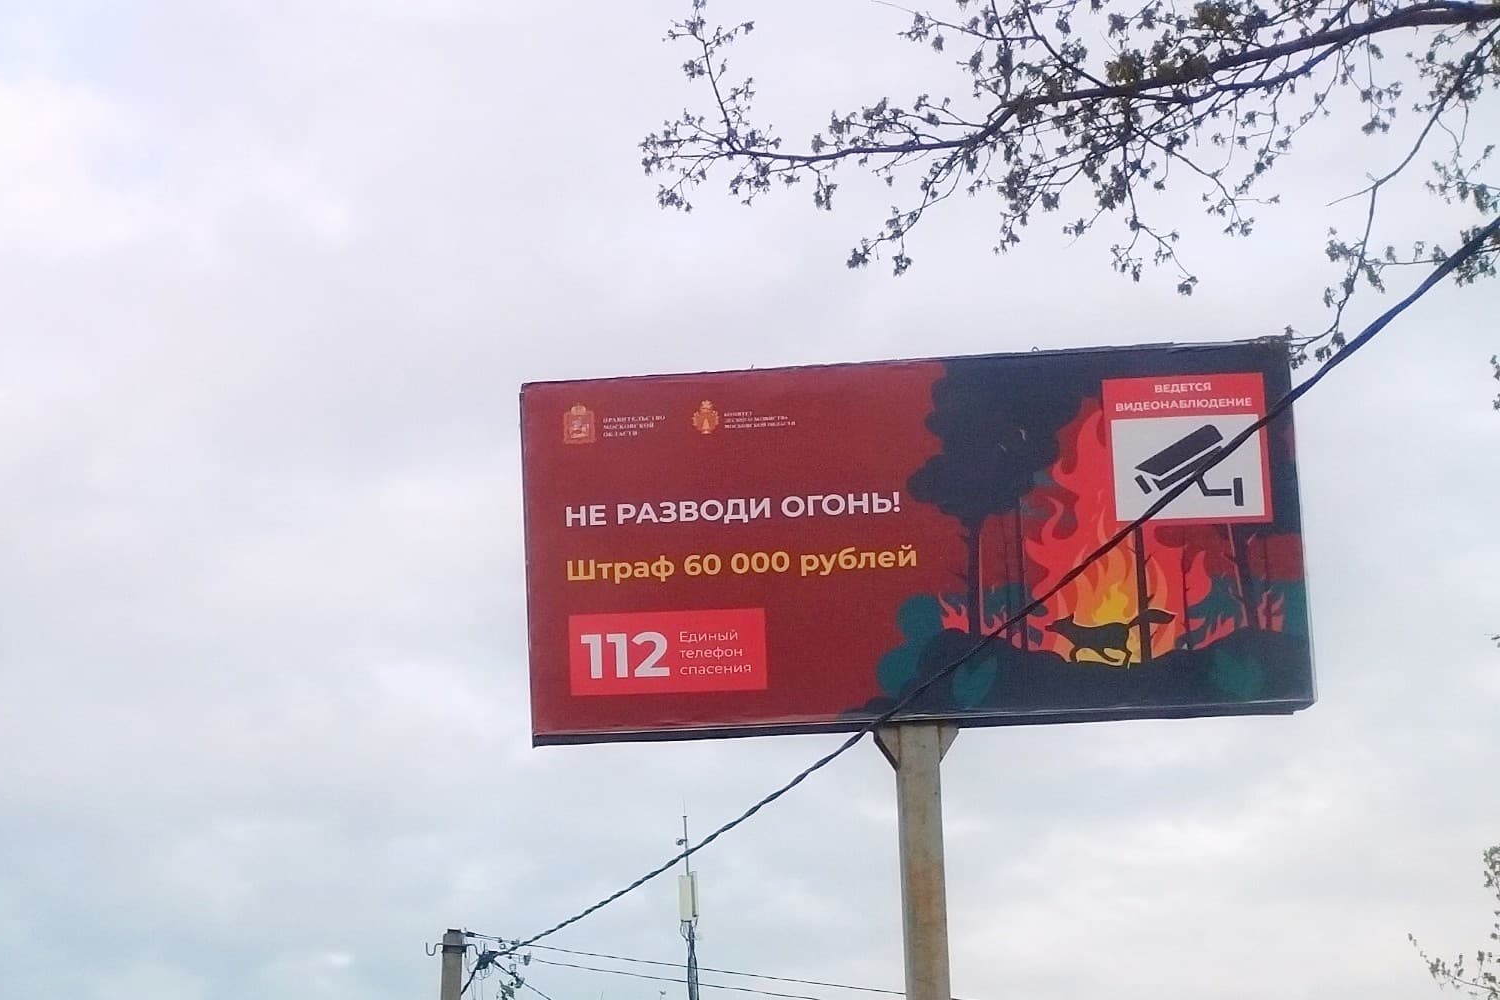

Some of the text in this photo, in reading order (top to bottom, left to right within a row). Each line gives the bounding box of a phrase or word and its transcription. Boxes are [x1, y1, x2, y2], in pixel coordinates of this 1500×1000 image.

[1154, 382, 1212, 394] ВЕДЕТСЯ
[1115, 397, 1252, 412] ВИДЕОНАБЛЮДЕНИЕ
[565, 491, 901, 527] НЕ РАЗВОДИ ОГОНЬ!
[566, 544, 918, 584] Штраф 60 000 рублей
[679, 629, 738, 643] Единый
[580, 631, 670, 679] 112
[680, 647, 743, 661] телефон
[680, 664, 752, 676] спасения
